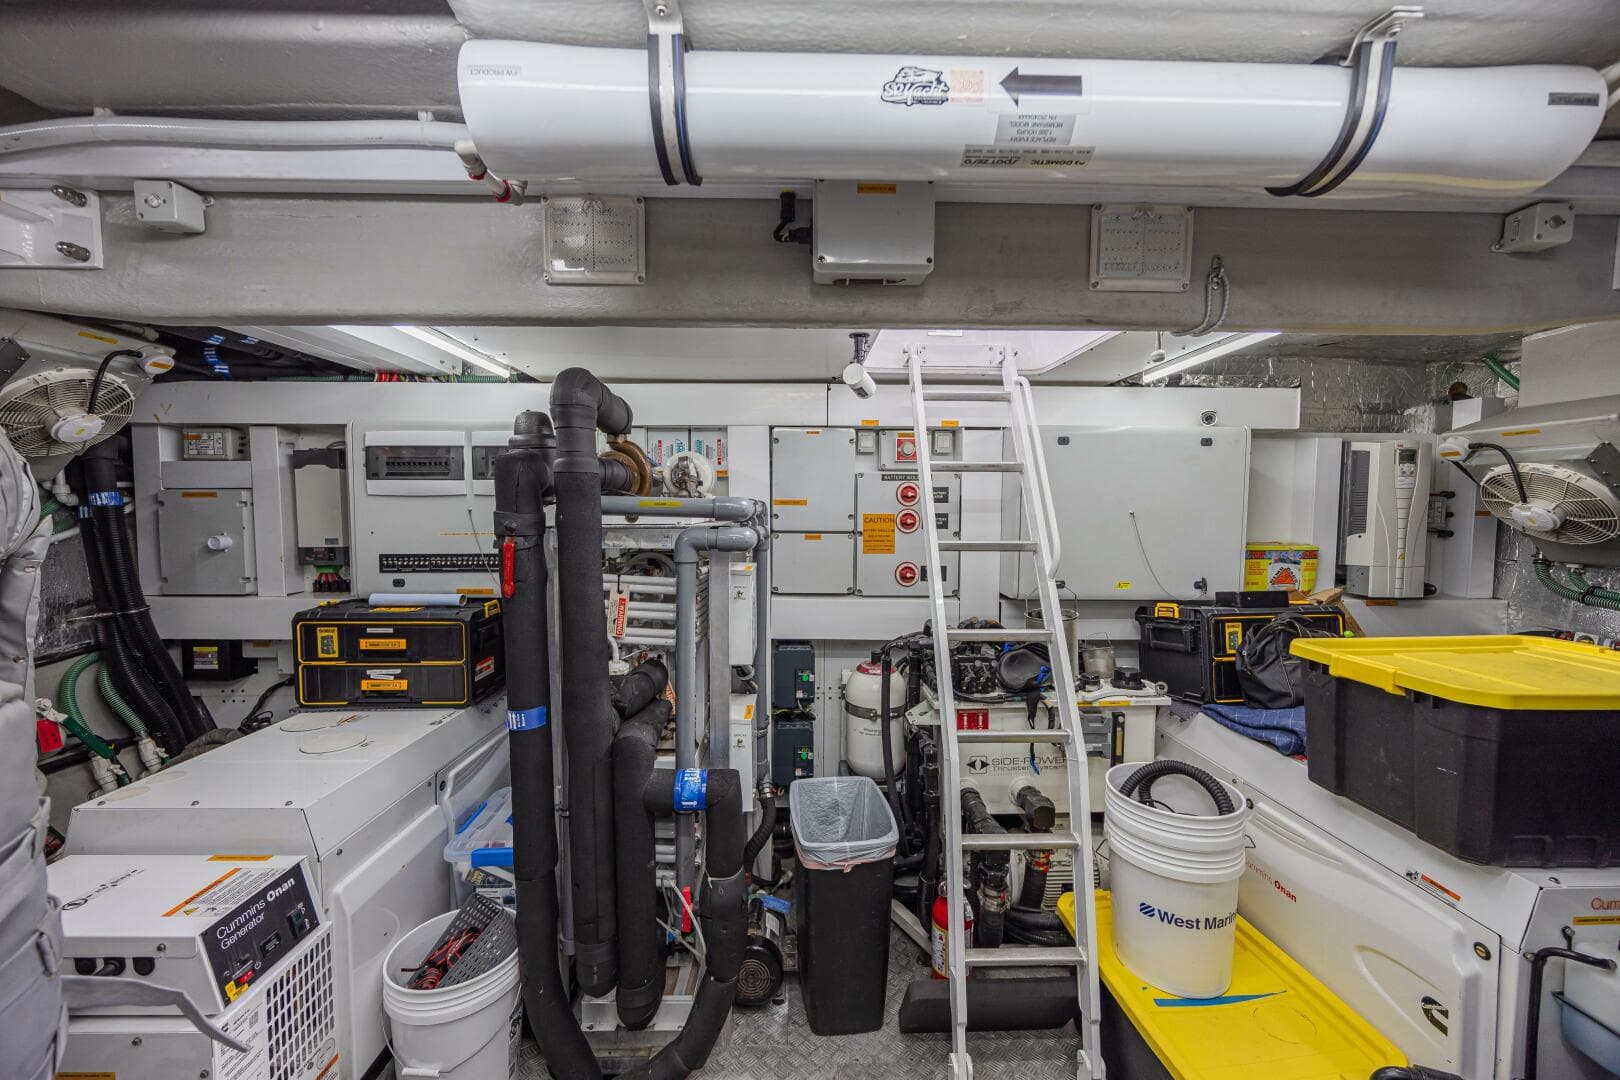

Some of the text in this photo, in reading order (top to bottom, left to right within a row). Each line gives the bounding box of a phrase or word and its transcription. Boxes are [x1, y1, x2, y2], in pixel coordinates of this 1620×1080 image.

[864, 516, 895, 524] CAUTION
[616, 605, 625, 635] WARNING
[1274, 880, 1297, 903] Onan
[216, 899, 266, 939] Cummins
[266, 878, 296, 902] Onan
[1157, 908, 1236, 931] West Marin
[220, 911, 265, 950] Generator
